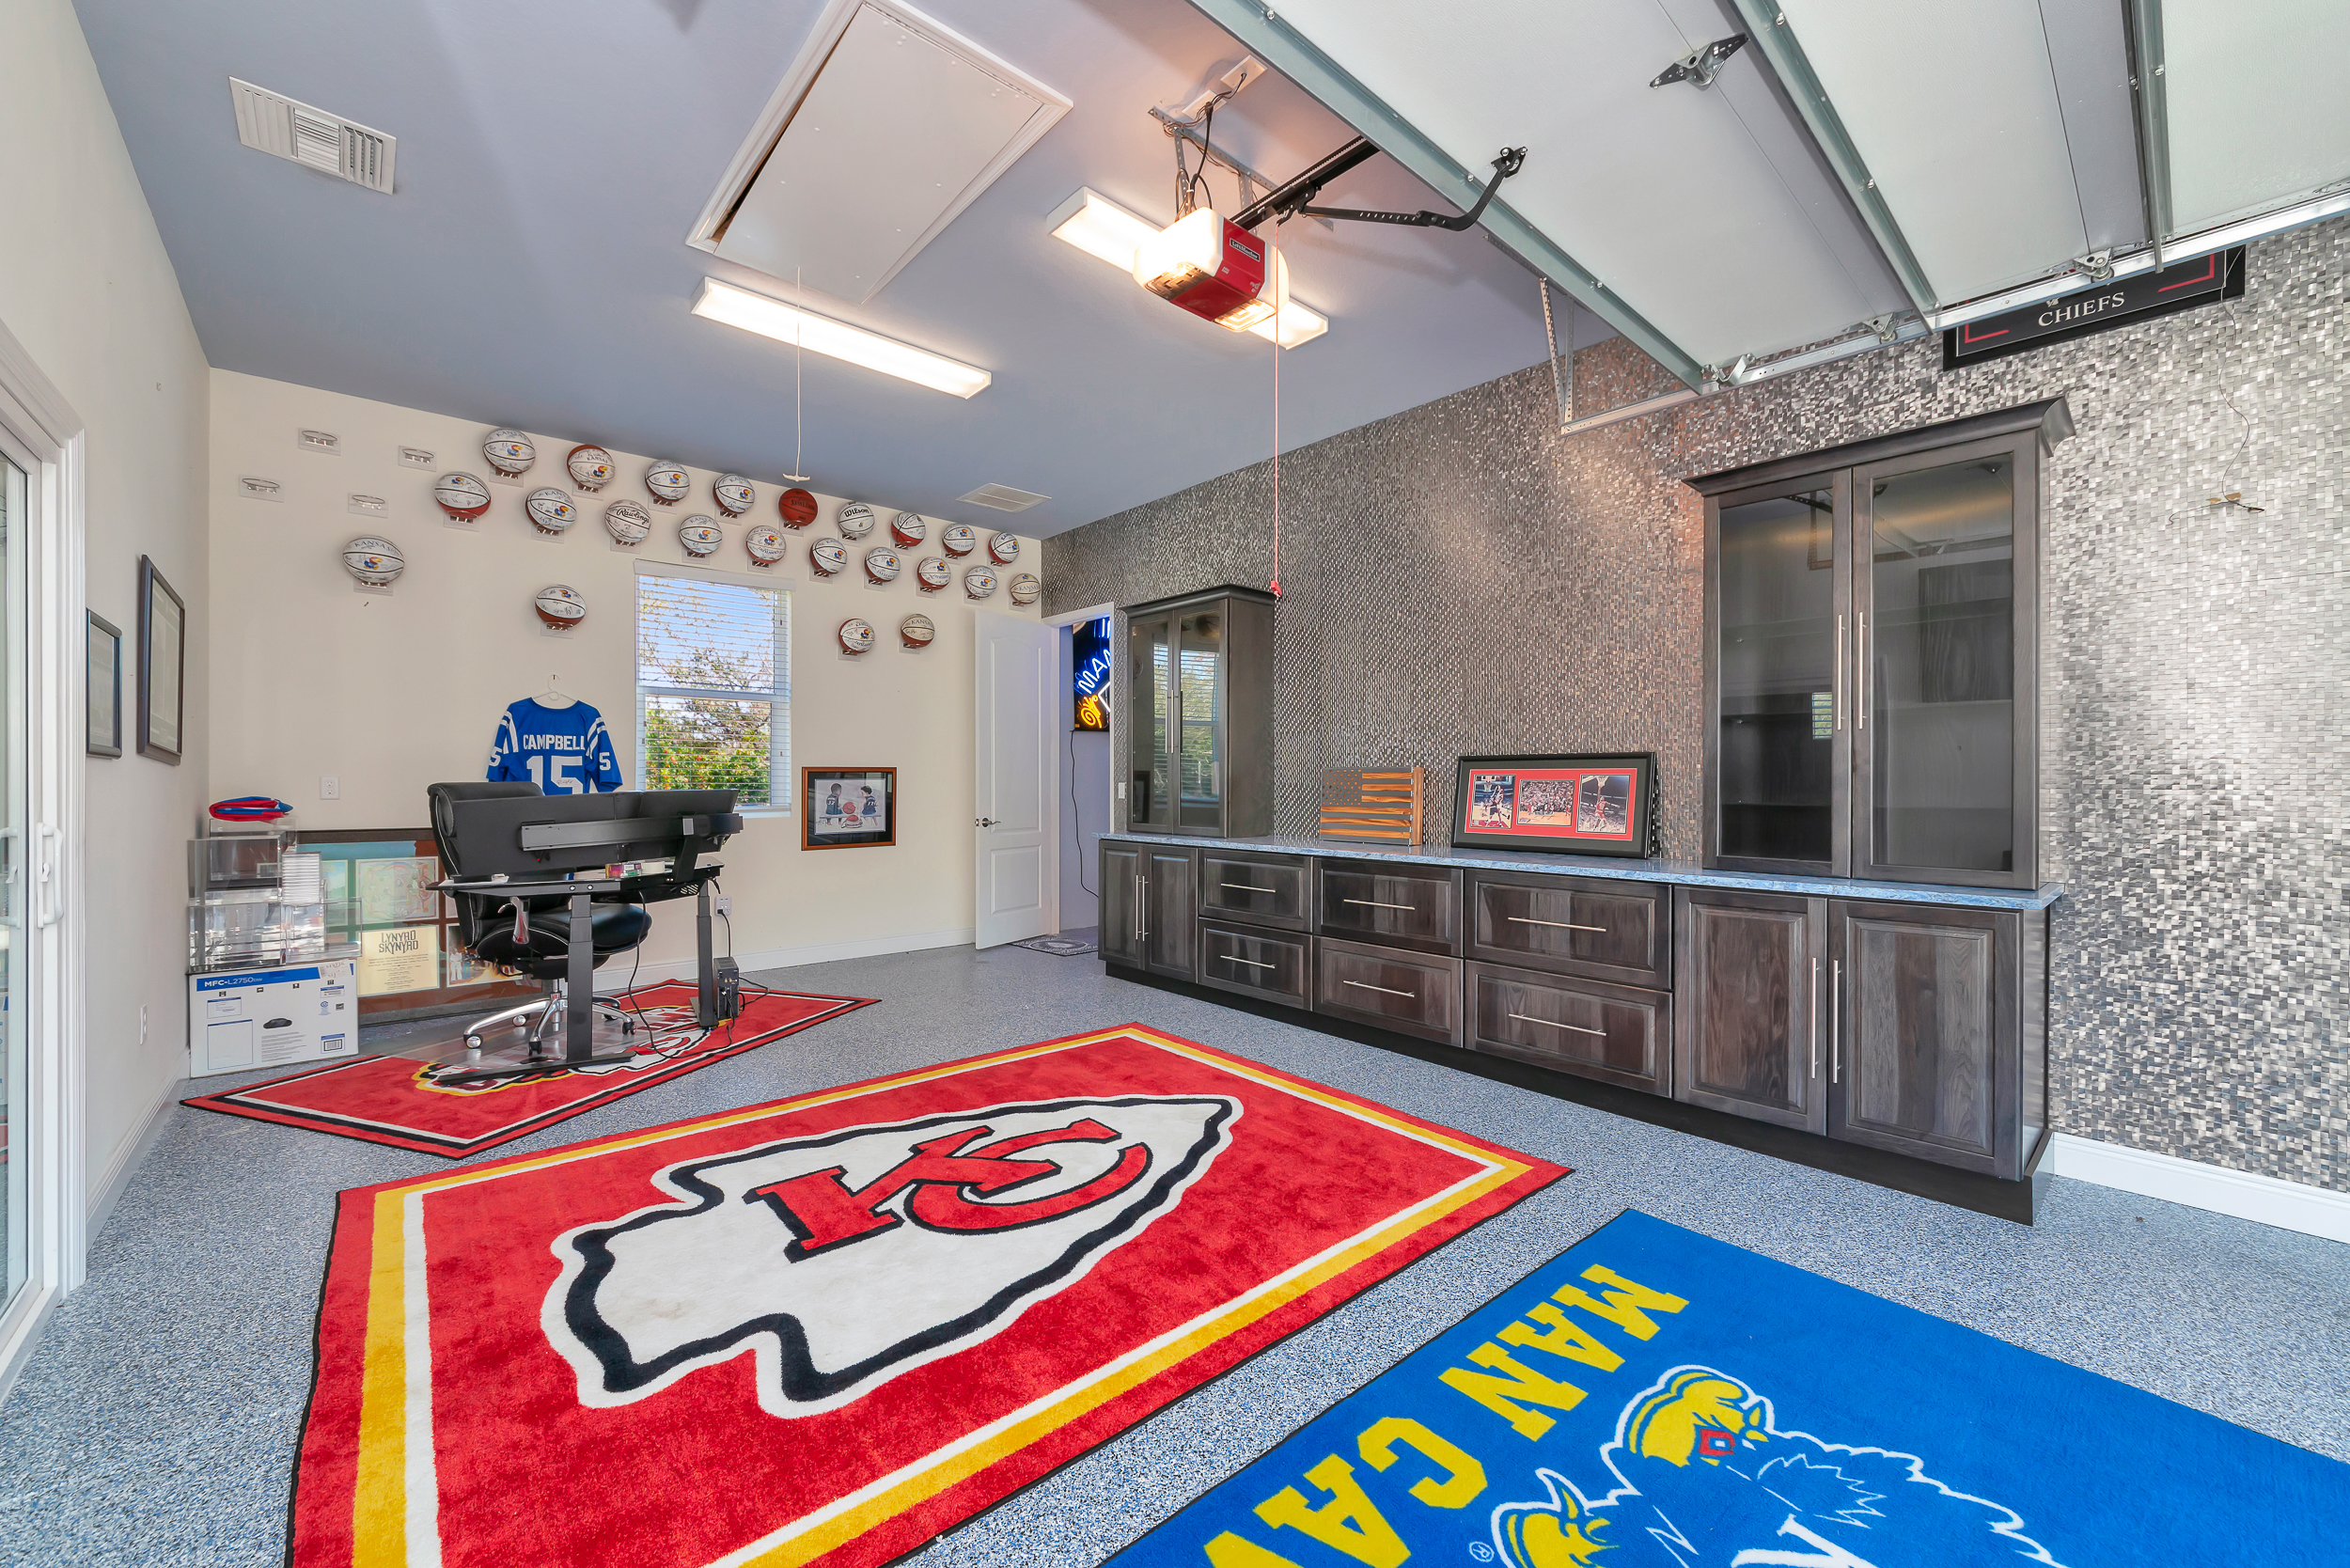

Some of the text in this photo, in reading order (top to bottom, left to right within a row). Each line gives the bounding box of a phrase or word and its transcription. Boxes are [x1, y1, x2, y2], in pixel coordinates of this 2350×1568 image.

[2038, 291, 2125, 328] CHIEFS
[616, 507, 650, 525] Rawlings
[844, 509, 870, 518] Wilson
[354, 541, 391, 553] KANSAS
[523, 734, 586, 750] CAMPBELL
[526, 756, 584, 795] 15
[381, 930, 416, 943] LYNYRD
[378, 940, 419, 954] SKYNYRD
[745, 1120, 1151, 1262] KC
[1437, 1263, 1690, 1442] MAN
